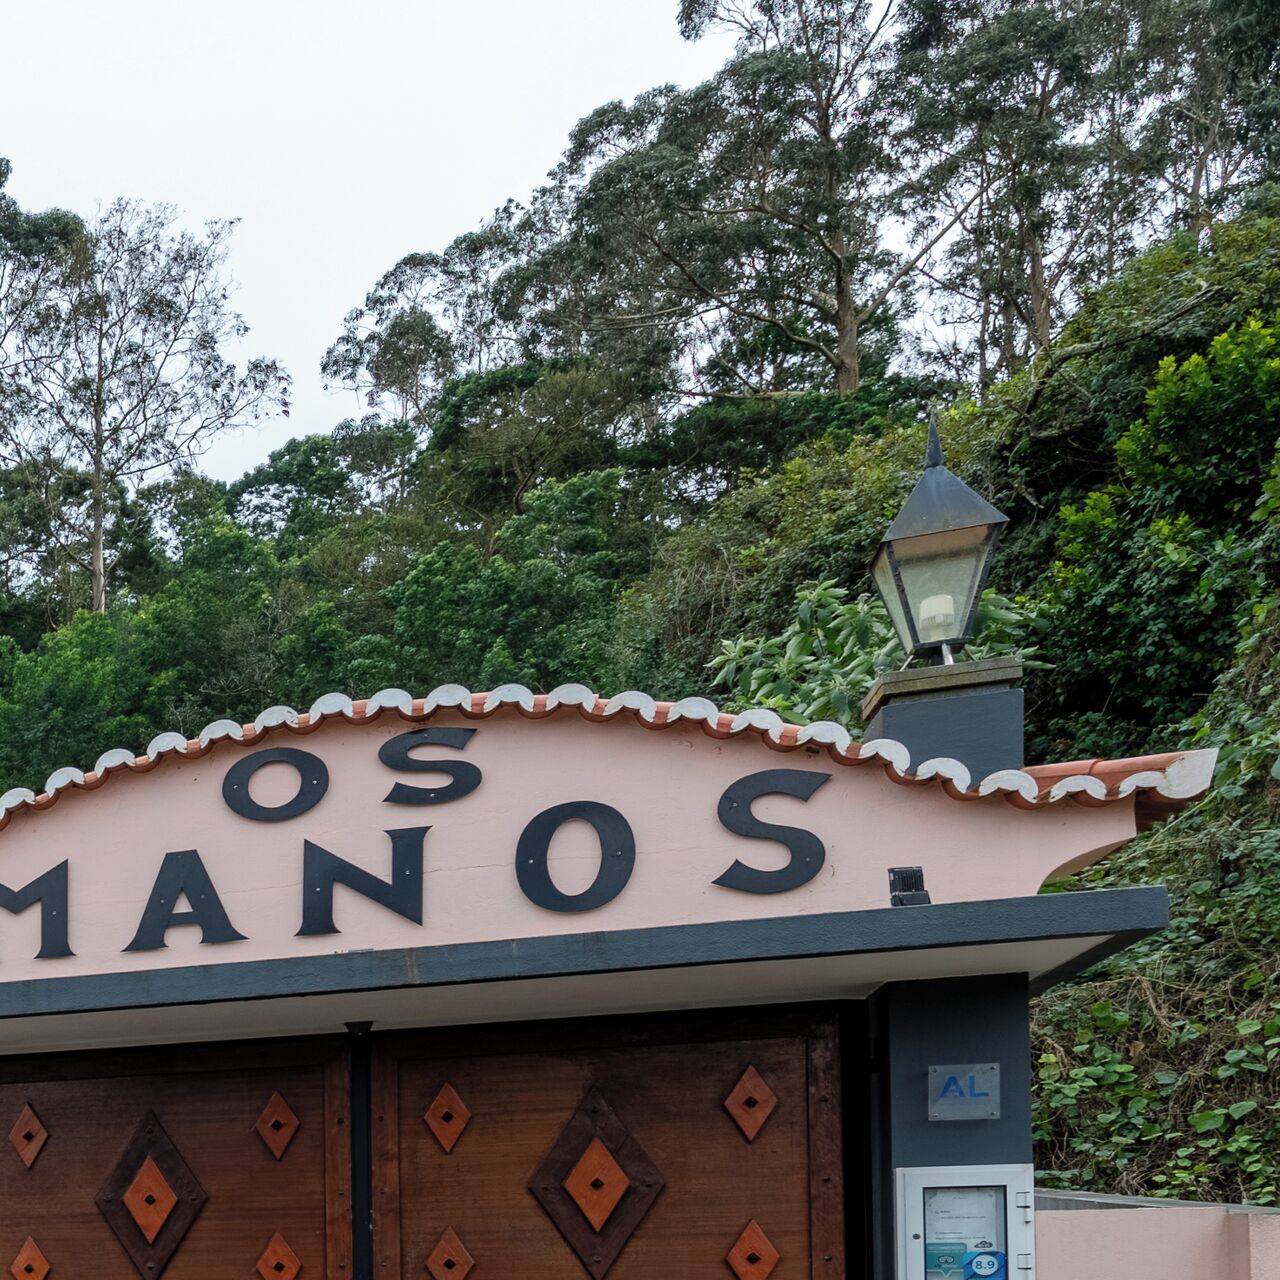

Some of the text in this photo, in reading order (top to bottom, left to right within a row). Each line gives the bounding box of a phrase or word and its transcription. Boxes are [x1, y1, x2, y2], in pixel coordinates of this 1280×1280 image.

[222, 727, 483, 823] OS
[940, 1075, 989, 1098] AL
[975, 1260, 995, 1270] 8.9
